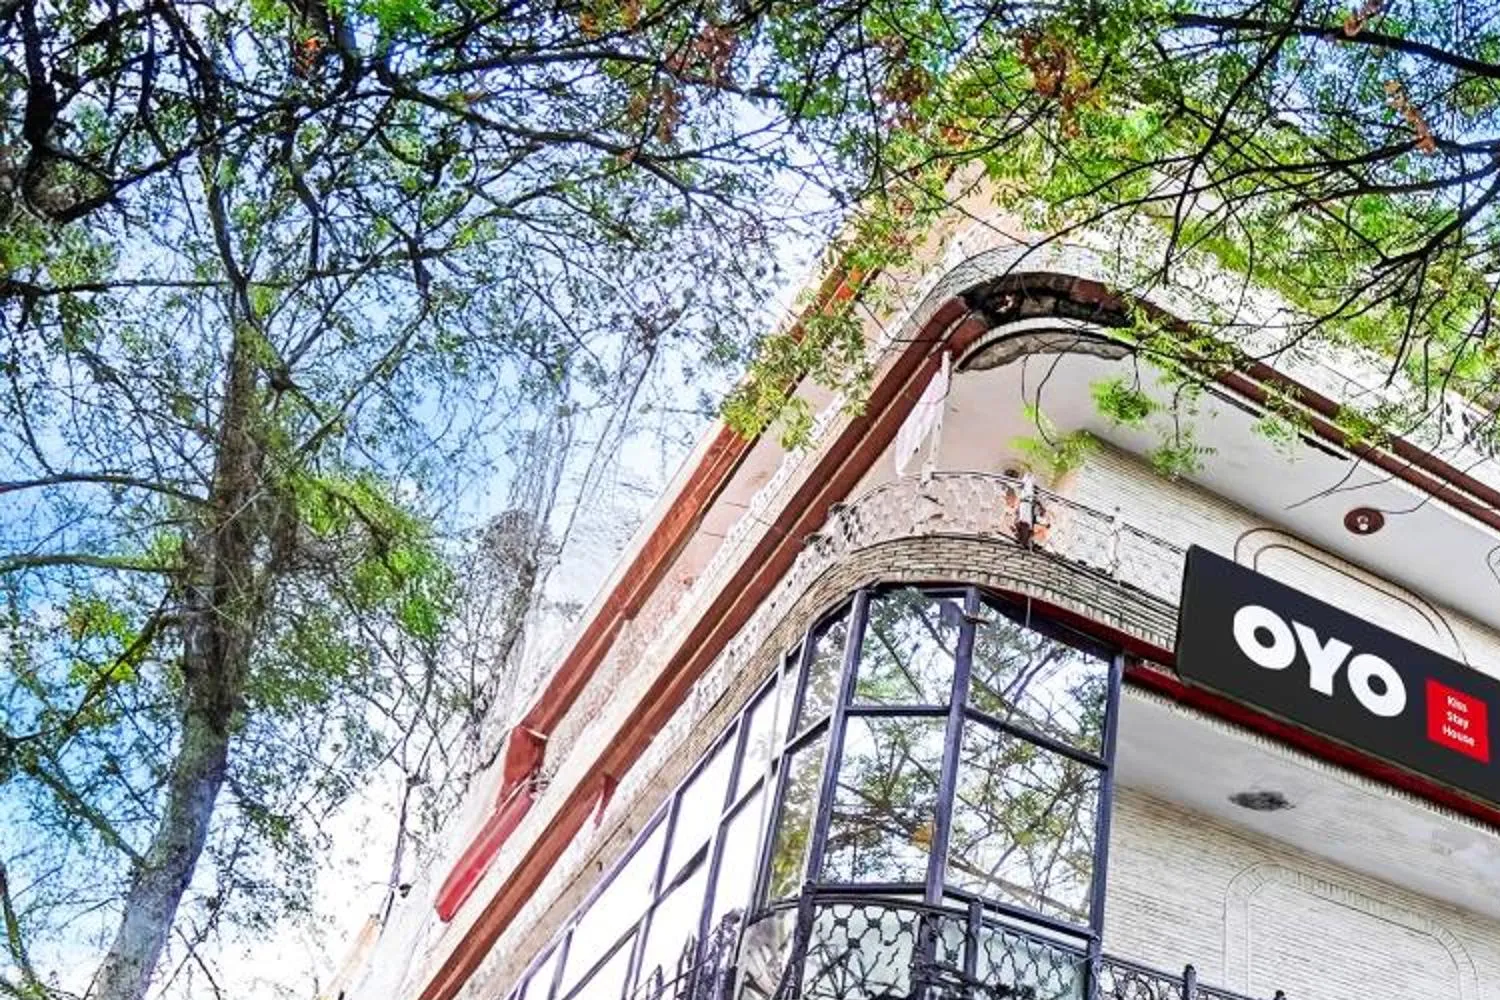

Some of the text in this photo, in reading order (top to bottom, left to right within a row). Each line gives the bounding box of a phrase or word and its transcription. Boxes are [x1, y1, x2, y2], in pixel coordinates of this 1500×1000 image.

[1233, 605, 1407, 717] OYO
[1446, 711, 1469, 731] Stay
[1442, 723, 1475, 747] House
